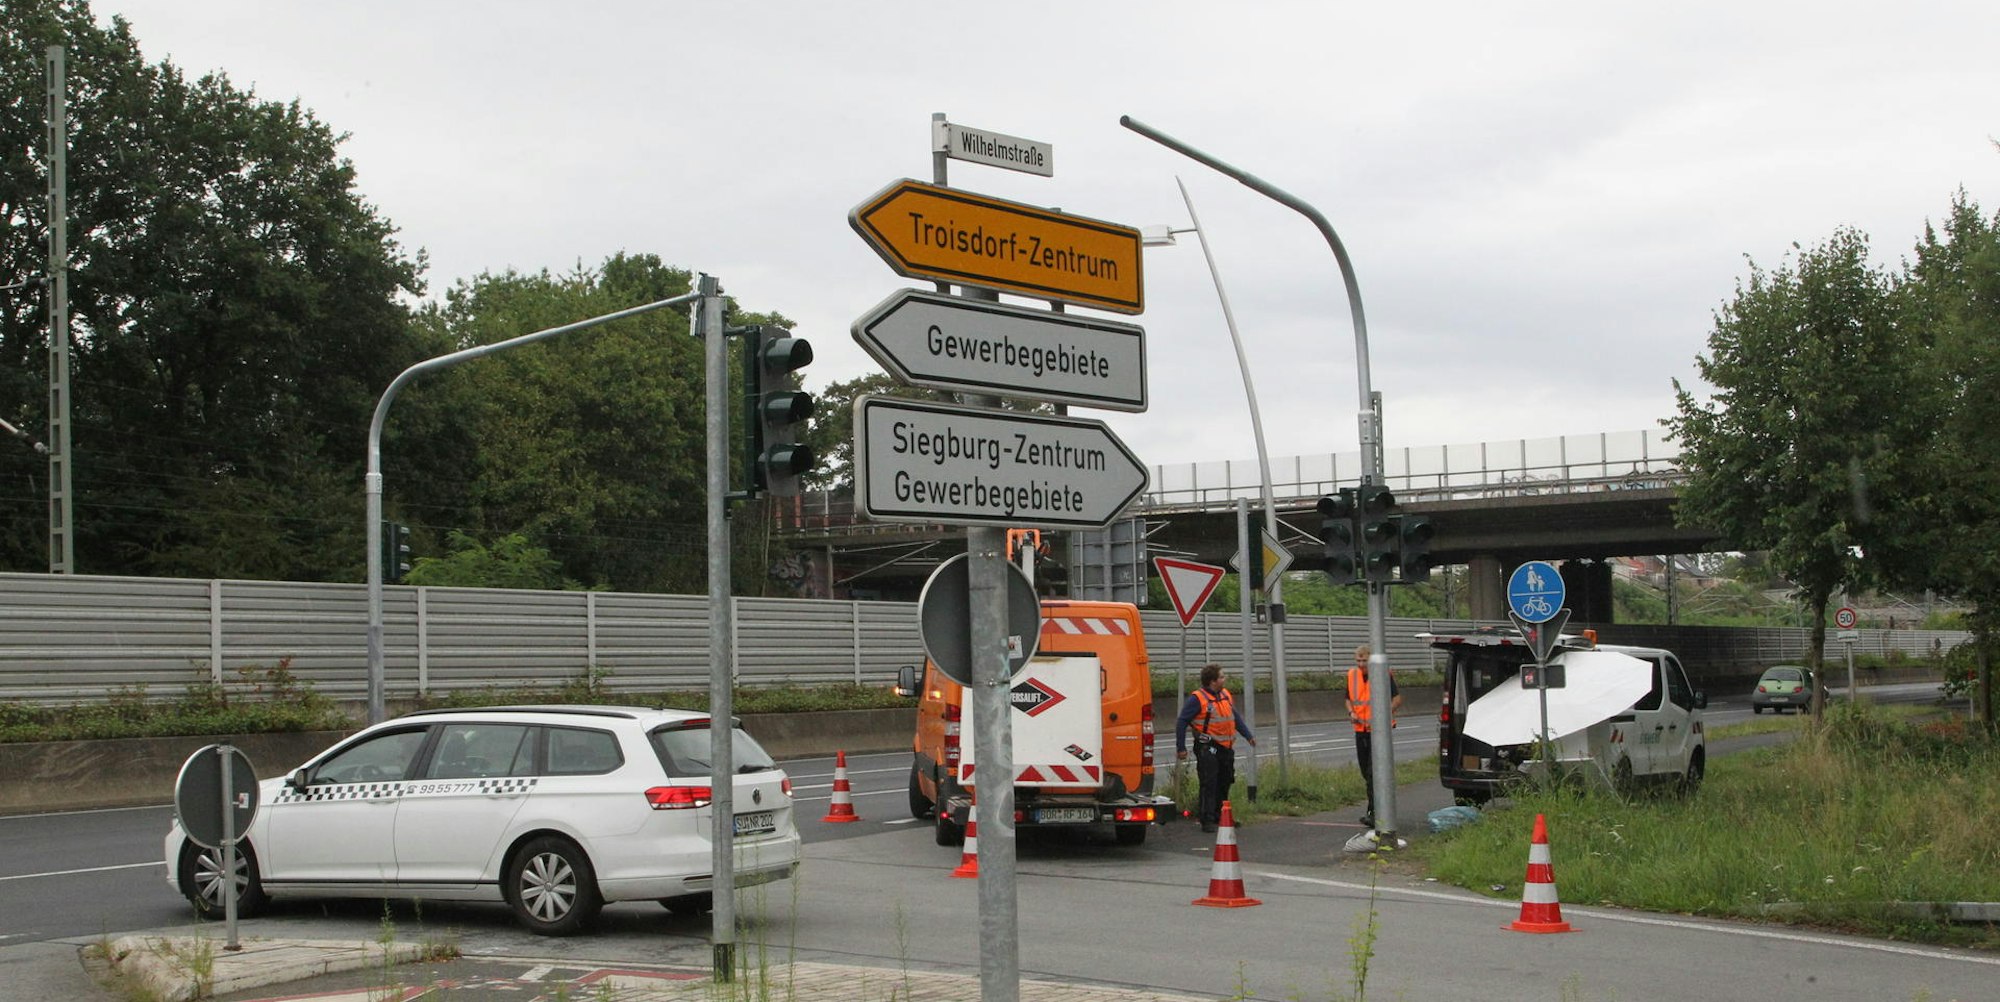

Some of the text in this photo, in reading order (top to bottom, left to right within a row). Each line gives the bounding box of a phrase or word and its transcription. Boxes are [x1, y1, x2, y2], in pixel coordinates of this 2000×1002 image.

[961, 131, 1044, 167] Wilhelmstraße
[908, 212, 1118, 281] Troisdorf-Zentrum
[927, 324, 1109, 378] Gewerbegebiete
[893, 421, 1105, 471] Siegburg-Zentrum
[895, 470, 1083, 517] Gewerbegebiete
[1839, 613, 1852, 623] 50
[419, 783, 475, 794] 99 55 777
